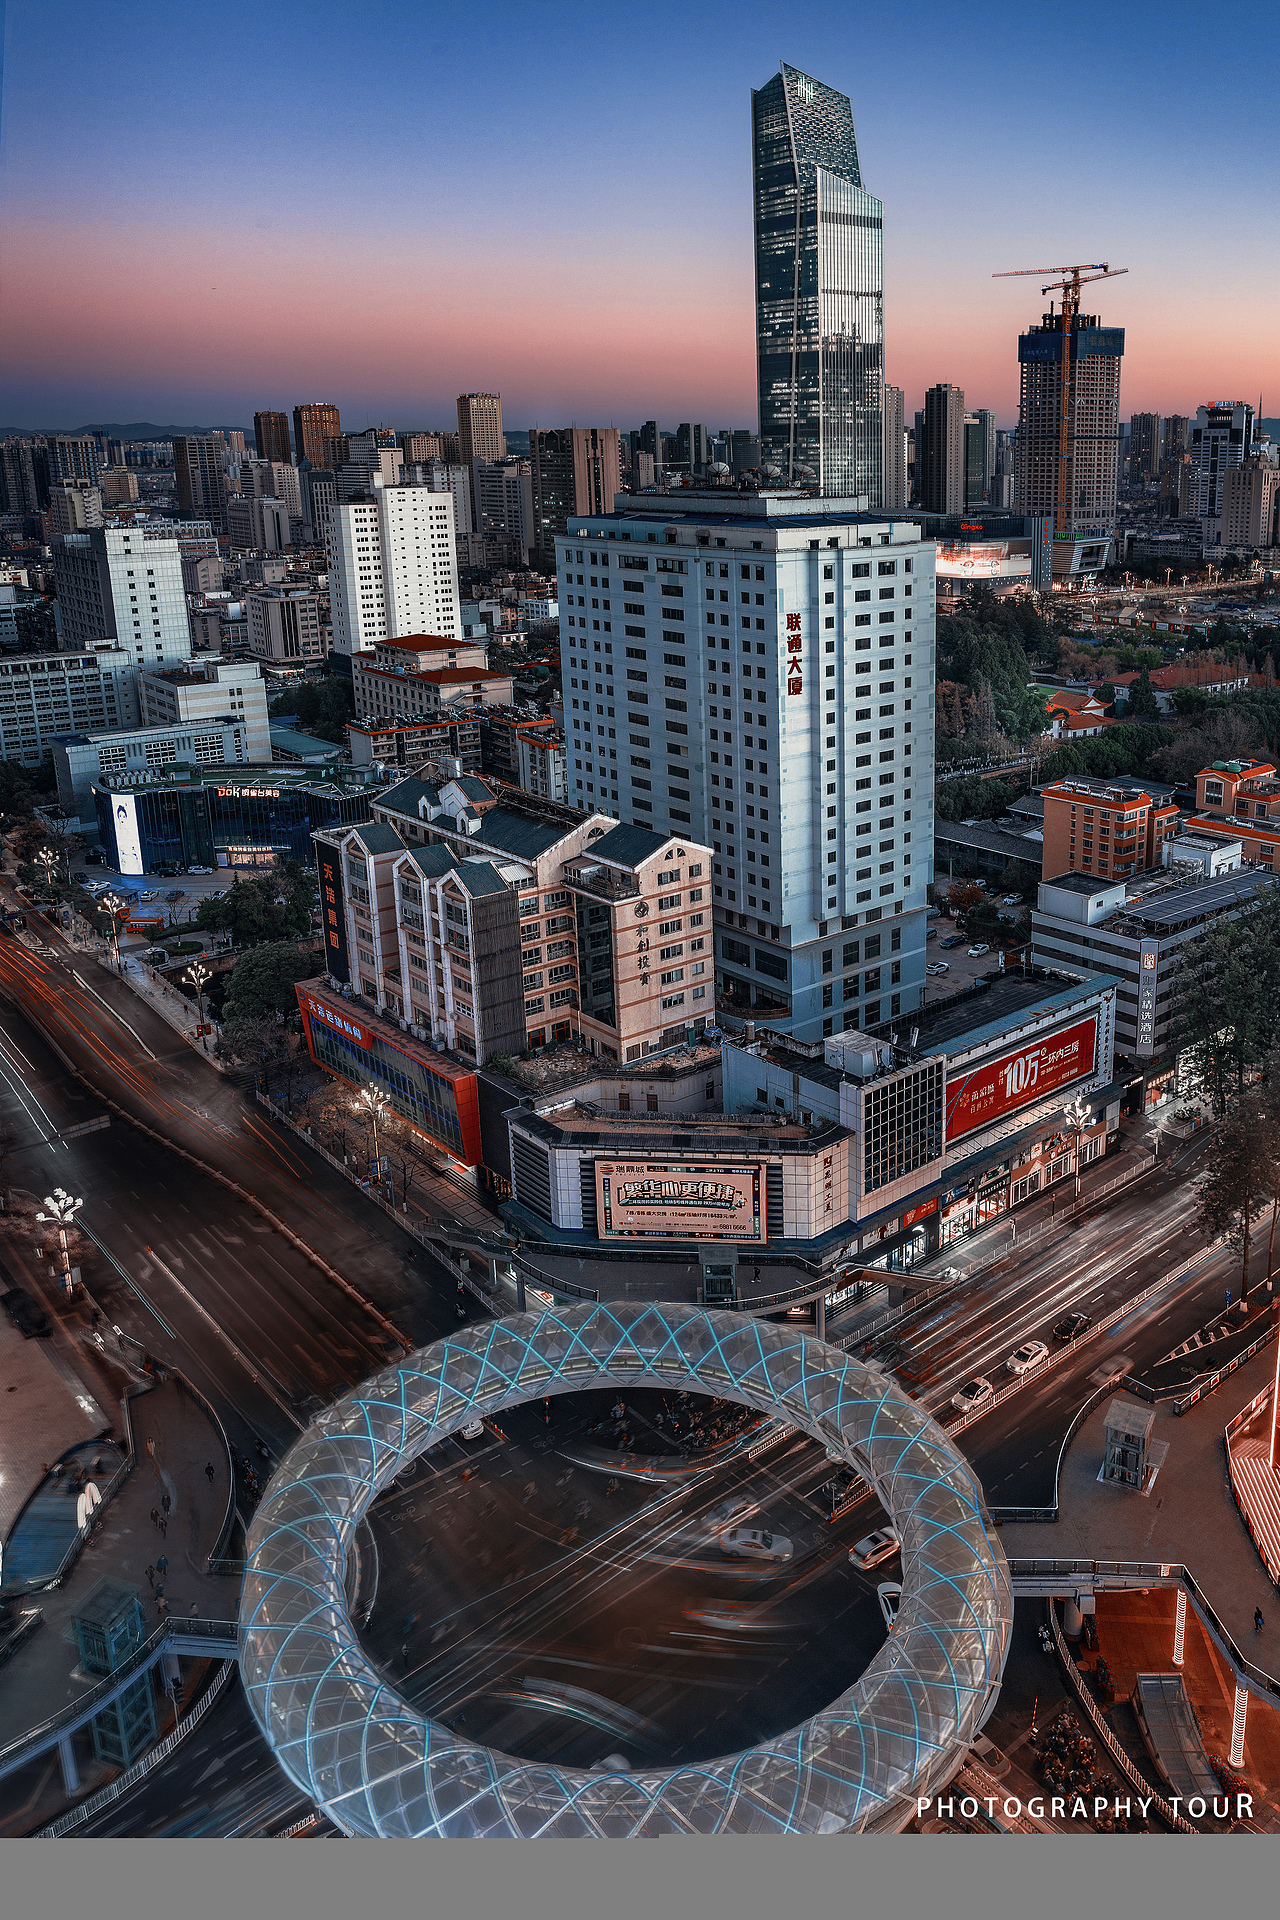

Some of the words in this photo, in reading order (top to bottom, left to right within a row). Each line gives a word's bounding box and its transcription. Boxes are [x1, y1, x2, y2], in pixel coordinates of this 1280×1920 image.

[960, 523, 983, 531] Gingko
[786, 612, 803, 696] 联通大厦
[1040, 1039, 1080, 1068] 二环内三房
